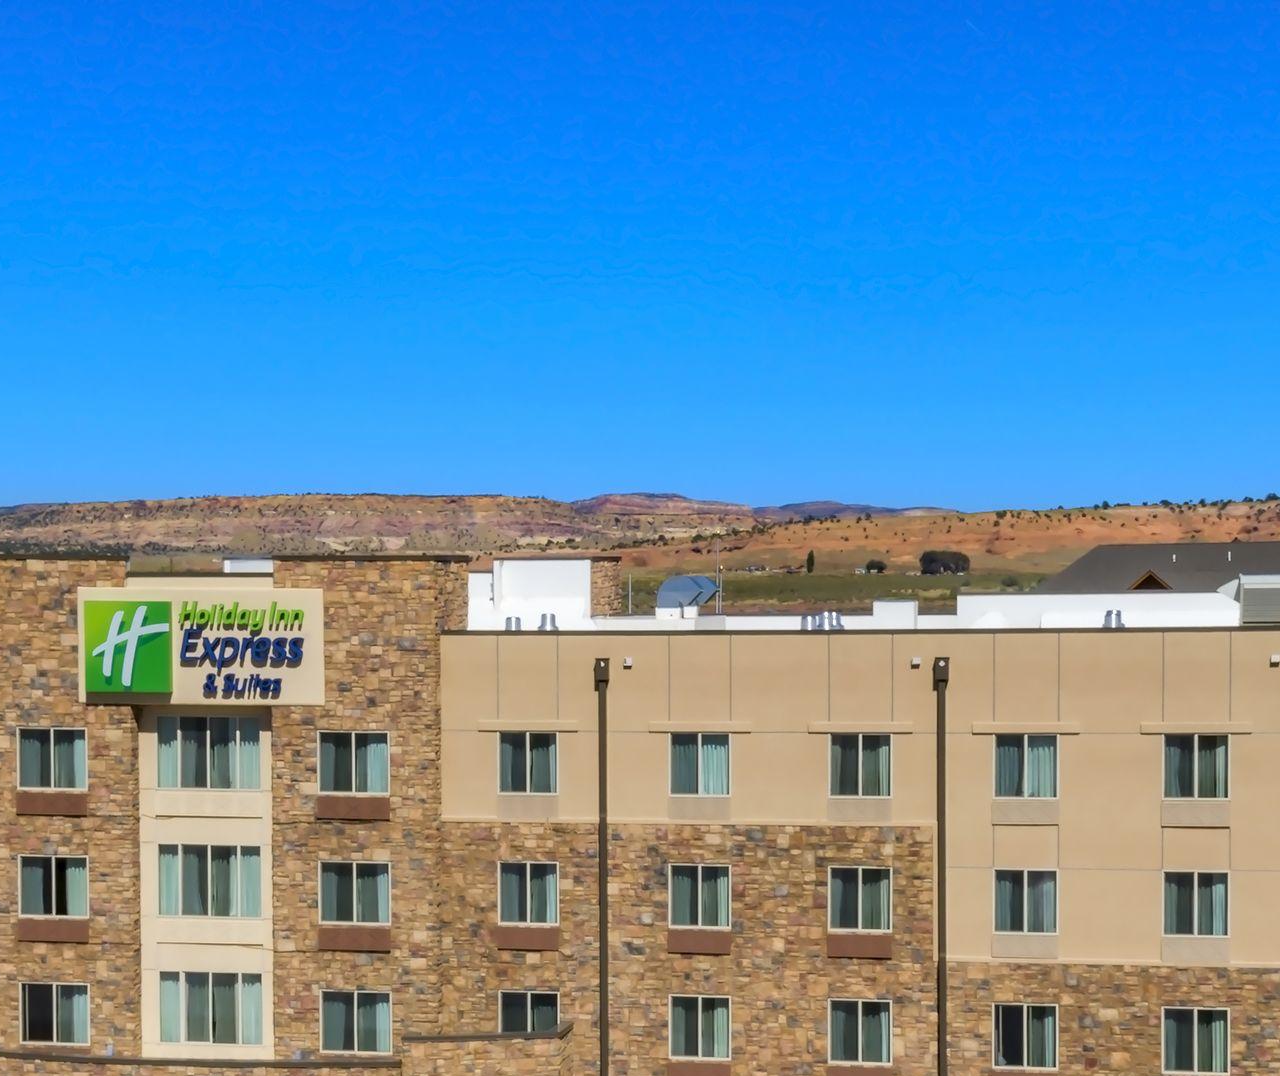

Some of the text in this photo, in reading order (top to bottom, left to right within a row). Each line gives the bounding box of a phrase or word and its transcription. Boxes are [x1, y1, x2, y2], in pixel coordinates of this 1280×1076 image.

[179, 601, 305, 631] Holiday Inn
[180, 628, 304, 671] Express
[203, 673, 282, 697] & Suites
